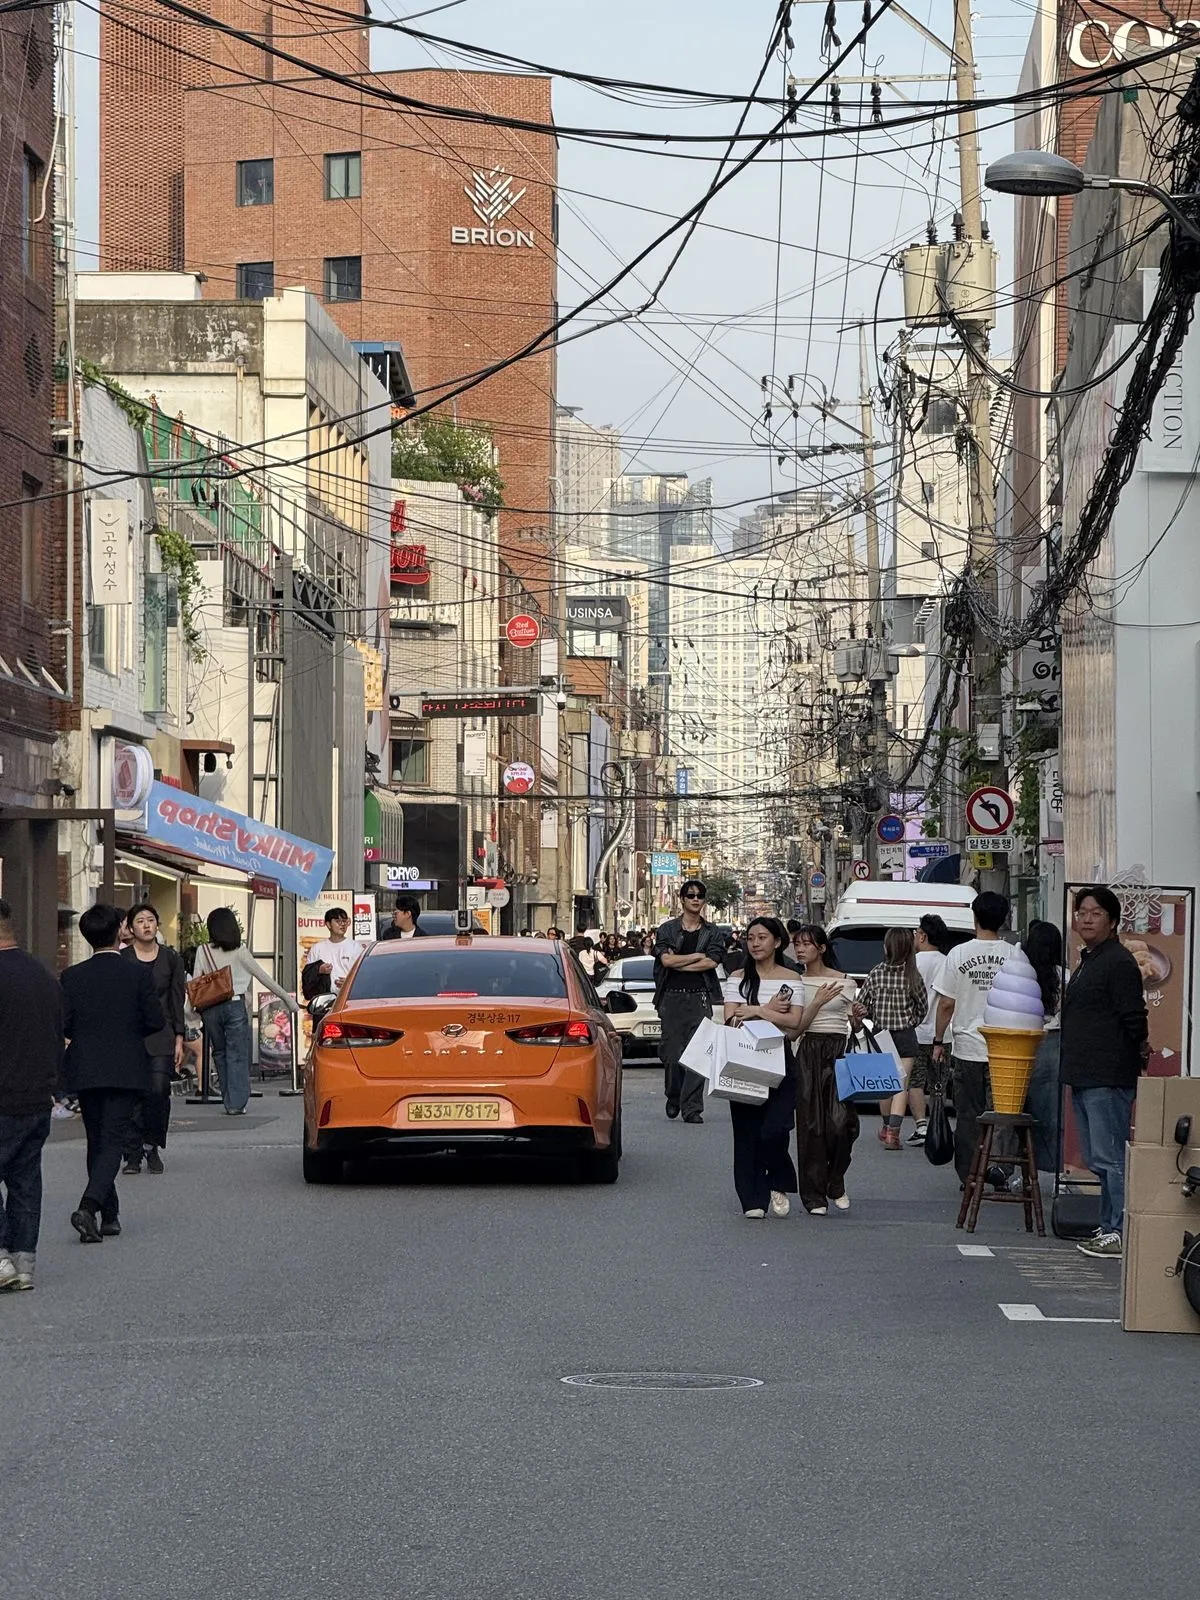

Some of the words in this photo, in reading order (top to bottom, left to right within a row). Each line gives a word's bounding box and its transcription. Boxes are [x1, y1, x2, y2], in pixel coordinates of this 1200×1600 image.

[452, 226, 534, 248] BRION
[102, 531, 118, 592] 고우성수
[970, 839, 1011, 849] 일방통행
[958, 957, 978, 974] DEUS
[977, 955, 986, 965] EX
[468, 1012, 506, 1024] 경북상운
[507, 1014, 520, 1023] 117
[853, 1075, 901, 1090] Verish
[455, 1104, 494, 1118] 7817
